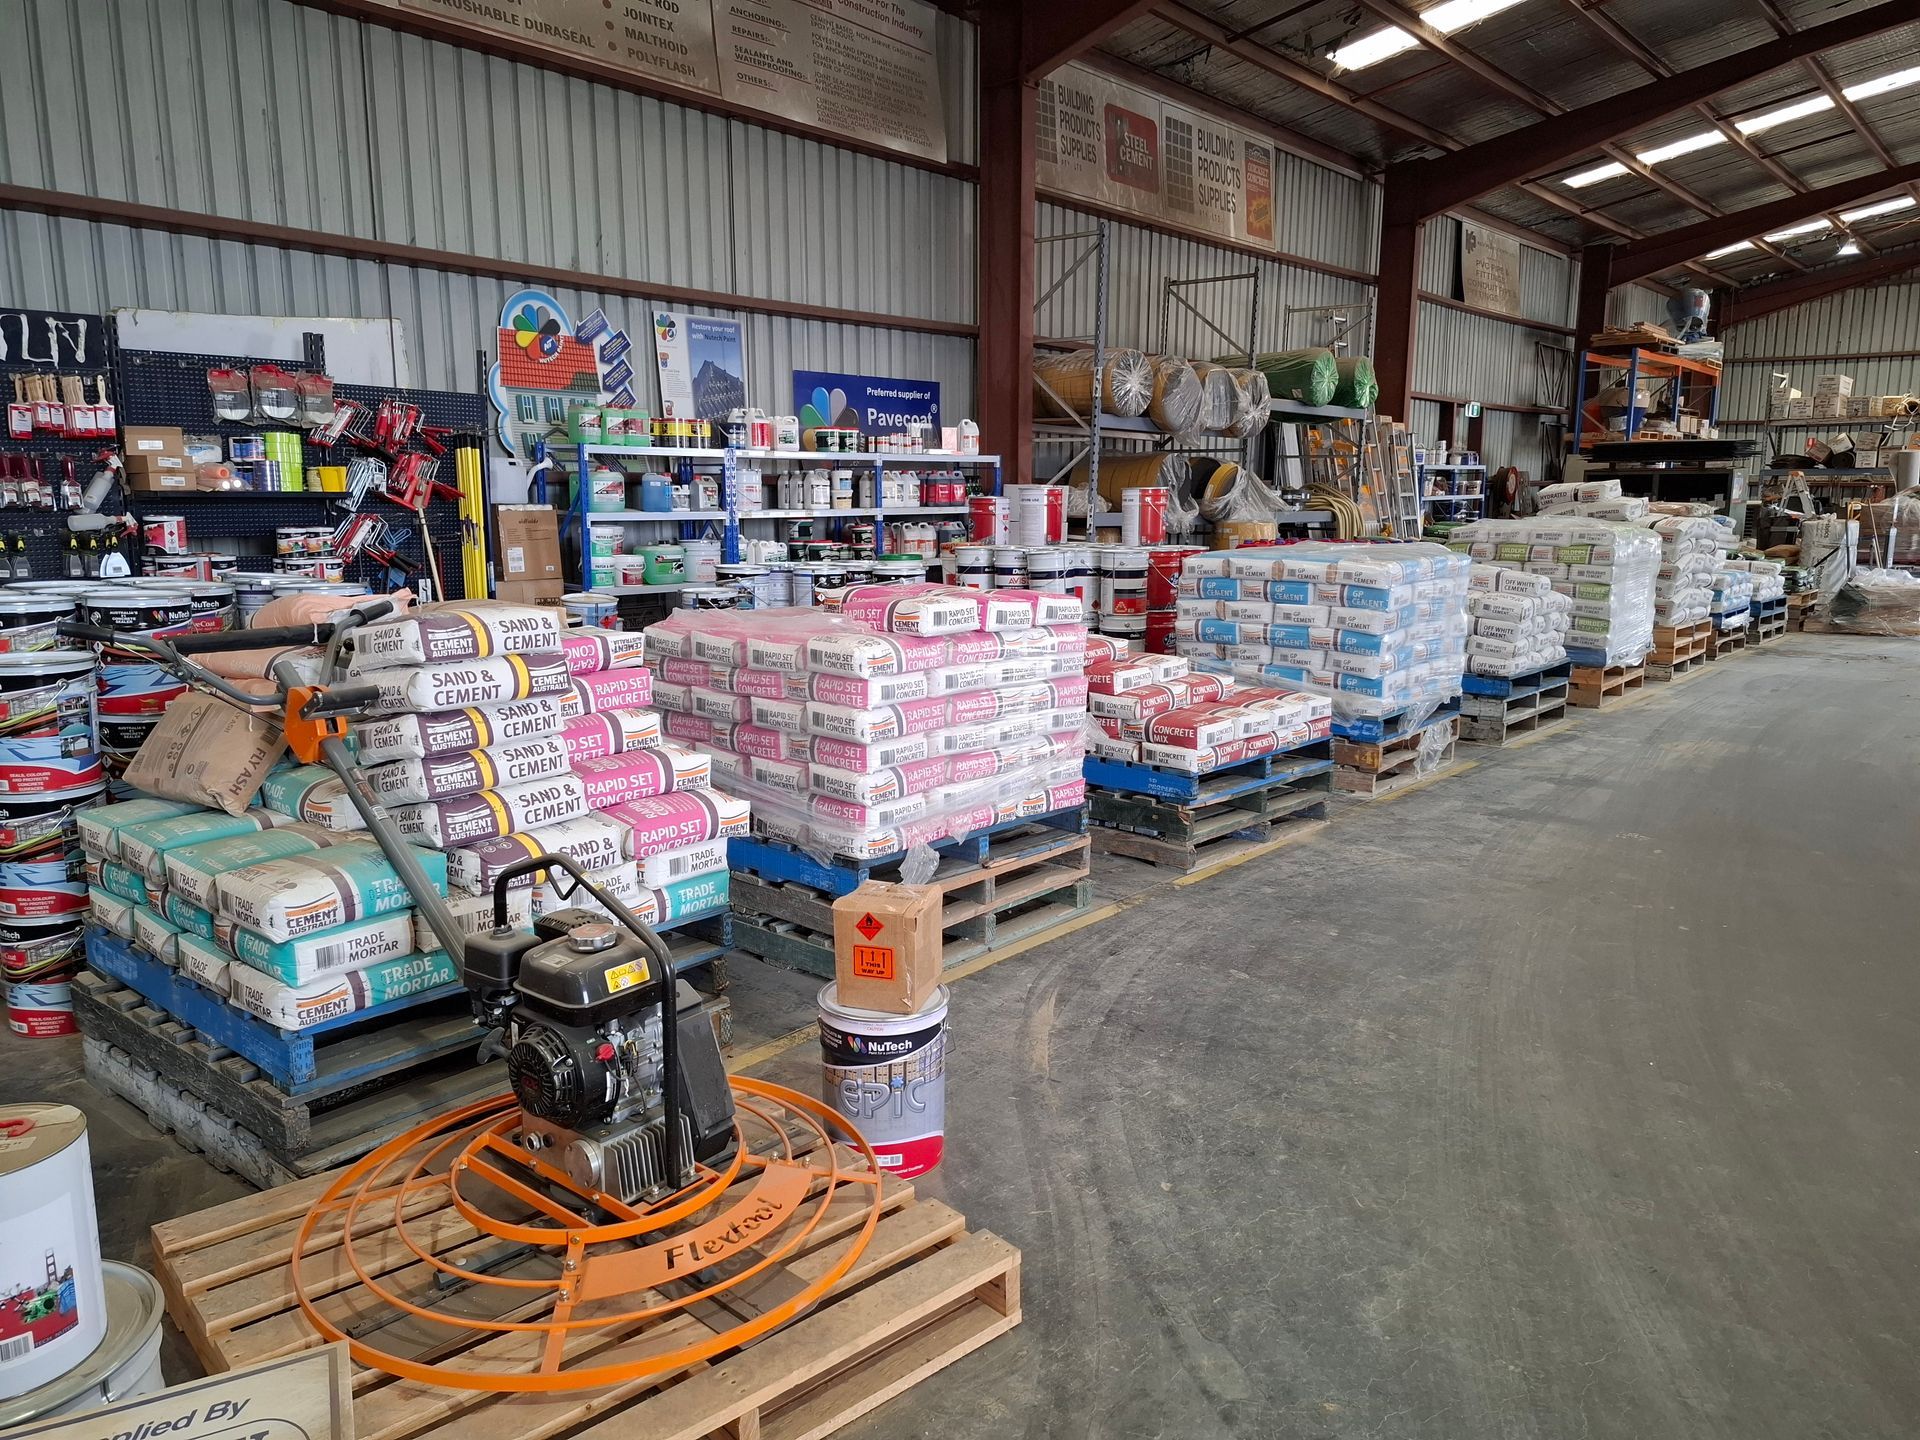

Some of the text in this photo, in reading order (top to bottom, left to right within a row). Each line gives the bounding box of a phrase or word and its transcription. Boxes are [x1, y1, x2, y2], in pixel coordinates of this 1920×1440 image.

[891, 4, 905, 16] The
[432, 0, 595, 48] RUSHABLE DURASEAL
[623, 7, 674, 32] JOINTEX
[892, 16, 924, 39] Industry
[625, 27, 688, 55] MALTHOID
[627, 48, 695, 77] POLYFLASH
[734, 45, 794, 68] SEALANTS AND
[1058, 84, 1094, 115] BUILDING
[1059, 110, 1101, 142] PRODUCTS
[1061, 135, 1097, 165] SUPPLIES
[1124, 132, 1149, 153] STEEL
[1197, 128, 1235, 161] BUILDING
[1120, 146, 1153, 171] CEMENT
[1198, 156, 1241, 189] PRODUCTS
[1198, 183, 1236, 214] SUPPLIES
[691, 322, 711, 331] Restore
[539, 350, 559, 363] NUTECH
[867, 387, 897, 397] Preferred
[898, 390, 923, 400] supplier
[1206, 582, 1216, 590] GP
[1207, 589, 1233, 597] CEMENT
[1352, 590, 1364, 598] GP
[192, 600, 220, 610] NuTech
[949, 606, 975, 618] RAPID SET
[1352, 597, 1389, 609] CEMENT
[168, 609, 190, 623] NuTech
[948, 616, 975, 626] CONCRETE
[1008, 609, 1030, 618] RAPID SET
[1008, 617, 1030, 626] CONCRETE
[373, 627, 401, 641] SAND &
[499, 617, 553, 633] SAND &
[895, 621, 919, 629] CEMENT
[1495, 627, 1514, 635] WHITE
[503, 631, 558, 651] CEMENT
[1482, 630, 1506, 639] CEMENT
[373, 640, 404, 654] CEMENT
[430, 638, 473, 651] CEMENT
[432, 647, 473, 658] AUSTRALIA
[432, 668, 495, 688] SAND &
[532, 673, 568, 687] CEMENT
[596, 676, 648, 695] RAPID SET
[434, 684, 501, 707] CEMENT
[532, 683, 569, 693] AUSTRALIA
[597, 690, 650, 710] CONCRETE
[1107, 703, 1133, 711] CONCRETE
[1143, 693, 1169, 708] CONCRETE
[497, 700, 552, 721] SAND &
[1143, 707, 1155, 718] MIX
[503, 714, 557, 738] CEMENT
[1154, 725, 1195, 738] CONCRETE
[1154, 735, 1169, 744] MIX
[1158, 752, 1186, 762] CONCRETE
[229, 747, 267, 796] FLY ASH
[565, 783, 577, 796] &
[305, 809, 333, 824] CEMENT
[640, 819, 702, 844] RAPID SET
[720, 823, 749, 835] CEMENT
[690, 848, 715, 862] TRADE
[691, 856, 722, 873] MORTAR
[678, 882, 715, 902] TRADE
[235, 895, 254, 914] TRADE
[680, 893, 726, 916] MORTAR
[235, 911, 261, 929] MORTAR
[287, 907, 339, 929] CEMENT
[288, 917, 338, 937] AUSTRALIA
[347, 931, 386, 950] TRADE
[348, 940, 399, 963] MORTAR
[382, 957, 433, 983] TRADE
[384, 966, 449, 1000] MORTAR
[297, 998, 348, 1020] CEMENT
[298, 1007, 348, 1027] AUSTRALIA
[868, 1040, 913, 1051] NuTech
[663, 1196, 782, 1271] Flextool
[203, 1398, 251, 1423] By
